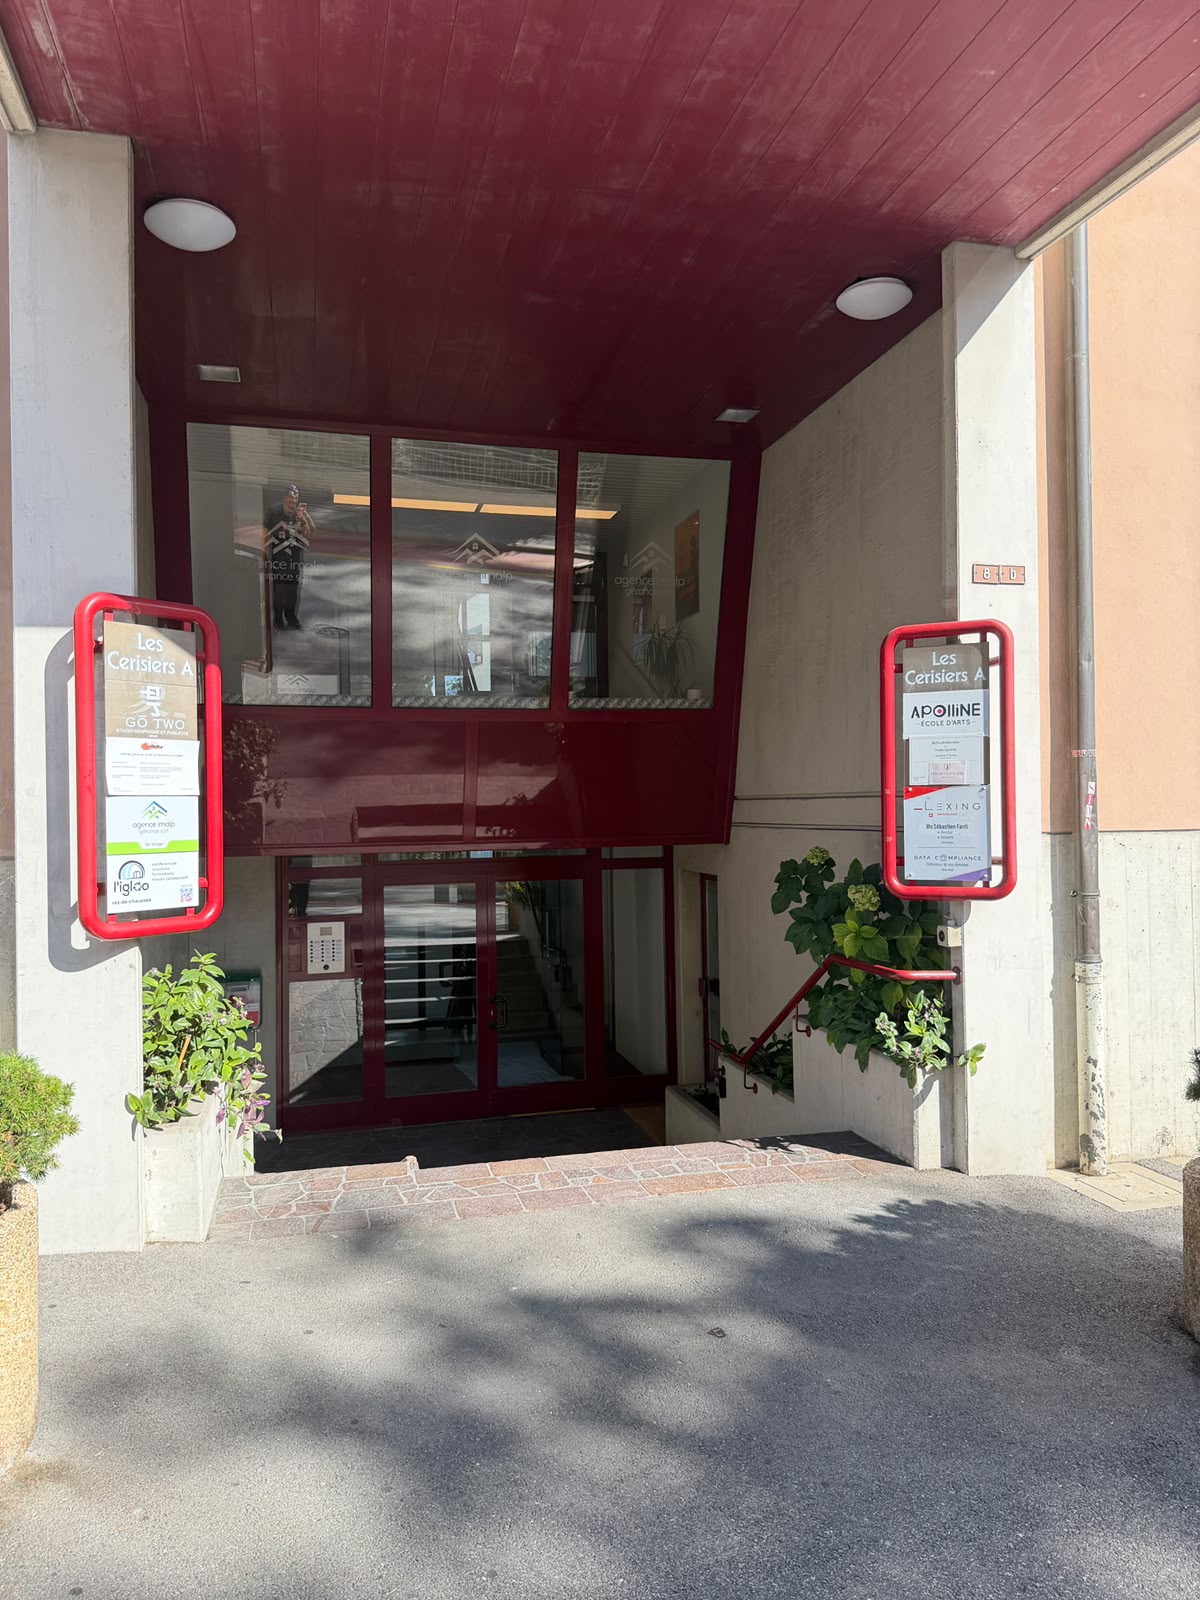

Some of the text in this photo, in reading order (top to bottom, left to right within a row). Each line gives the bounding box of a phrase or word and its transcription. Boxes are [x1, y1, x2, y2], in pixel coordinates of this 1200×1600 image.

[983, 567, 1017, 580] 8 b
[136, 632, 164, 653] Les
[107, 651, 194, 676] Cerisiers A
[932, 652, 957, 666] Les
[904, 666, 987, 685] Cerisiers A
[154, 718, 185, 730] TWO
[921, 719, 944, 727] ÉCOLE
[924, 801, 981, 811] LEXING
[132, 820, 175, 832] agence imalp
